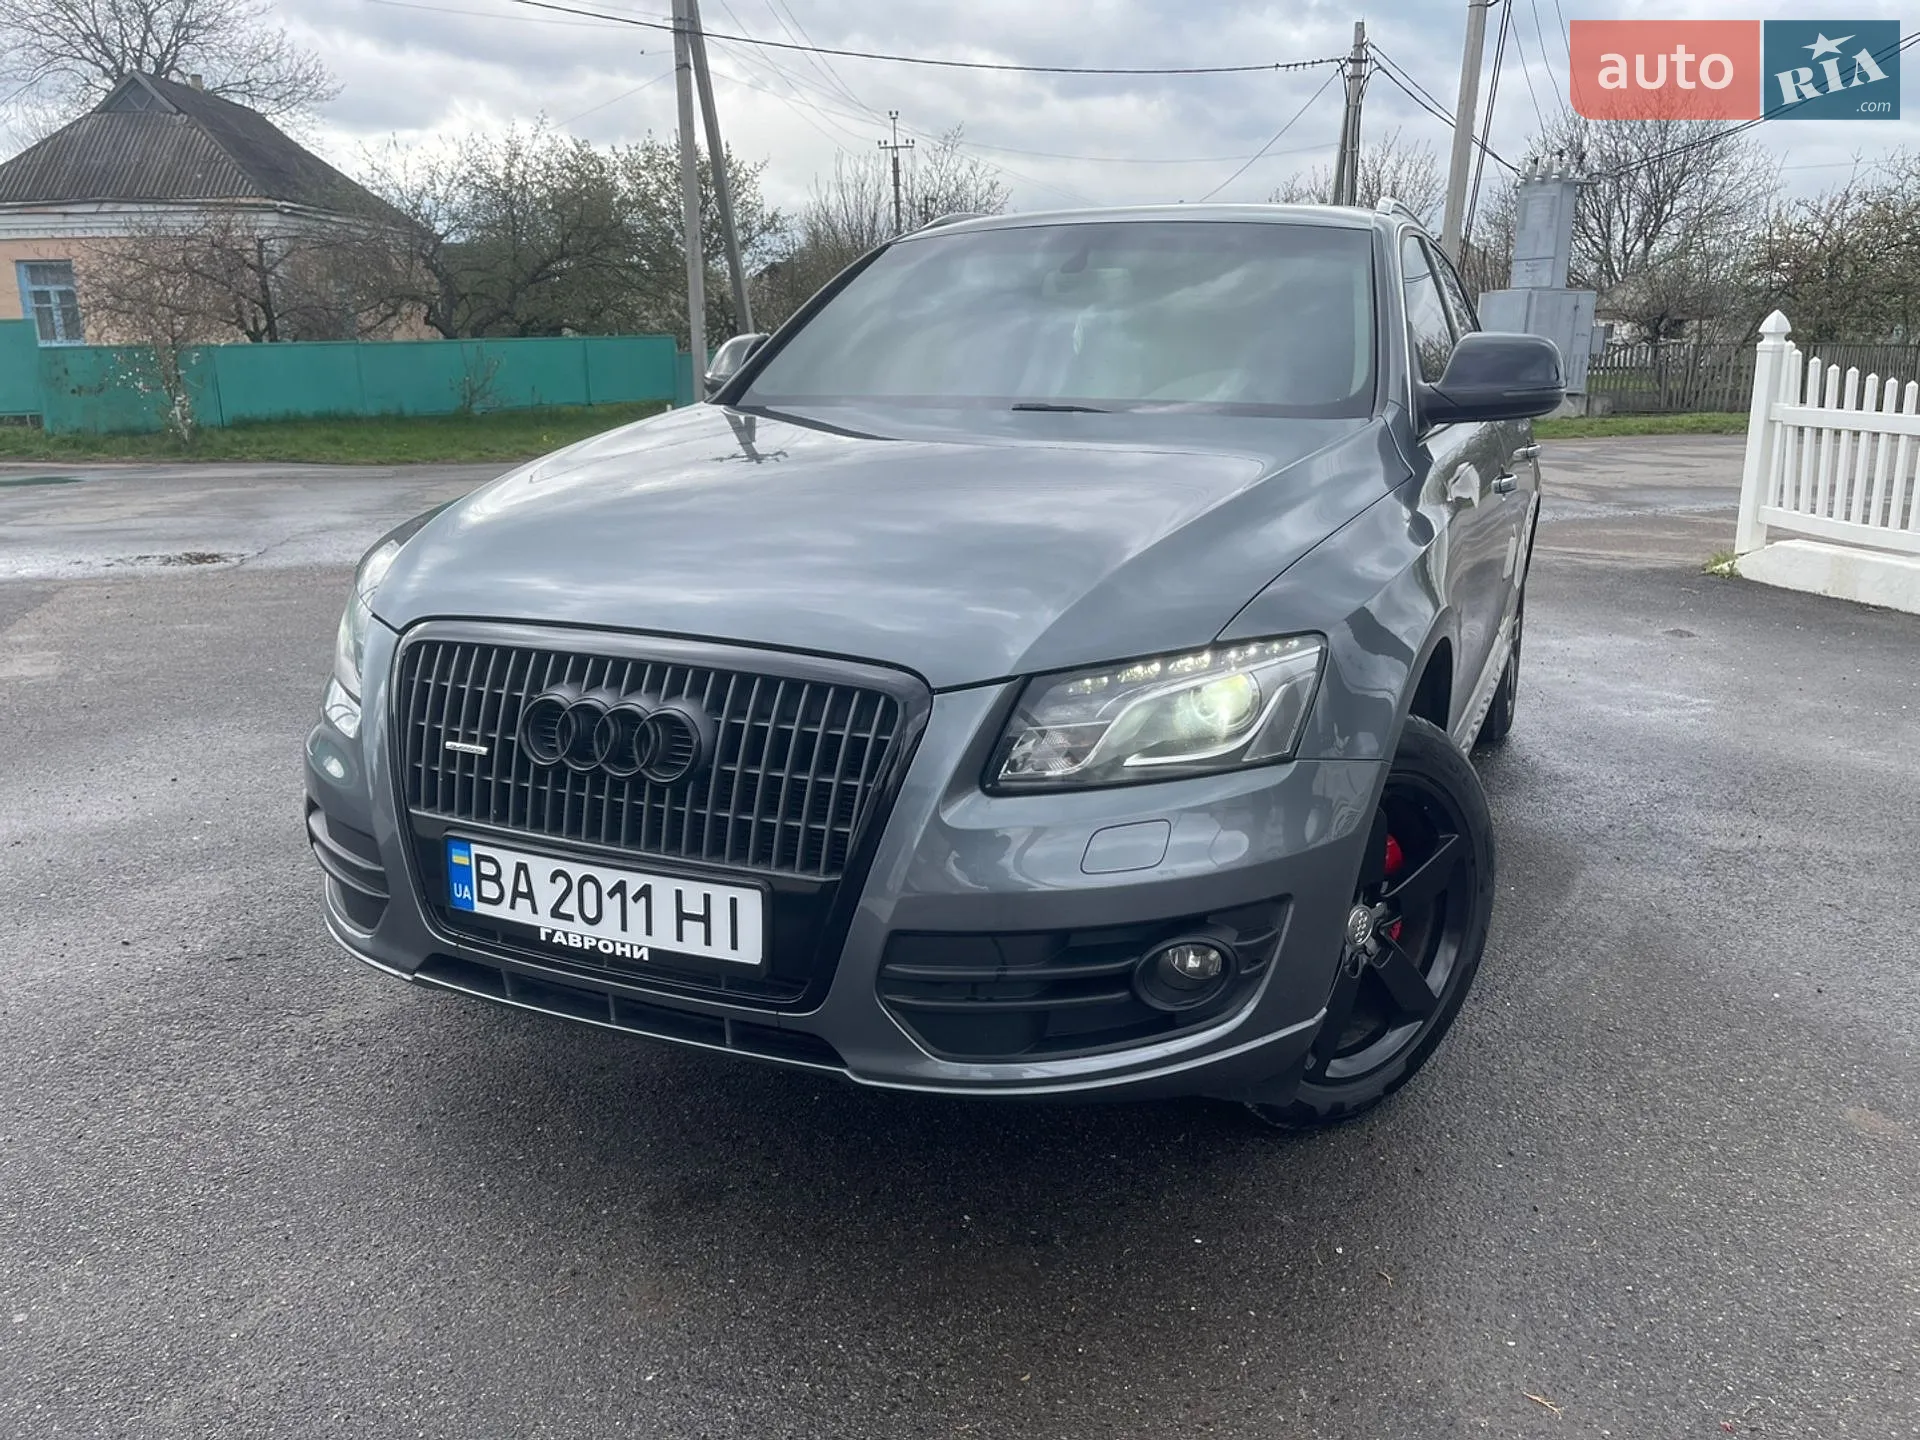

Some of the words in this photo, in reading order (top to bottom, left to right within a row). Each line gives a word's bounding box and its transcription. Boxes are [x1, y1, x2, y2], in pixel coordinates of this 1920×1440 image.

[453, 882, 472, 901] UA
[475, 853, 538, 915] BA
[549, 869, 653, 936] 2011
[675, 888, 738, 951] HI
[540, 927, 649, 961] ГАВРОНИ
